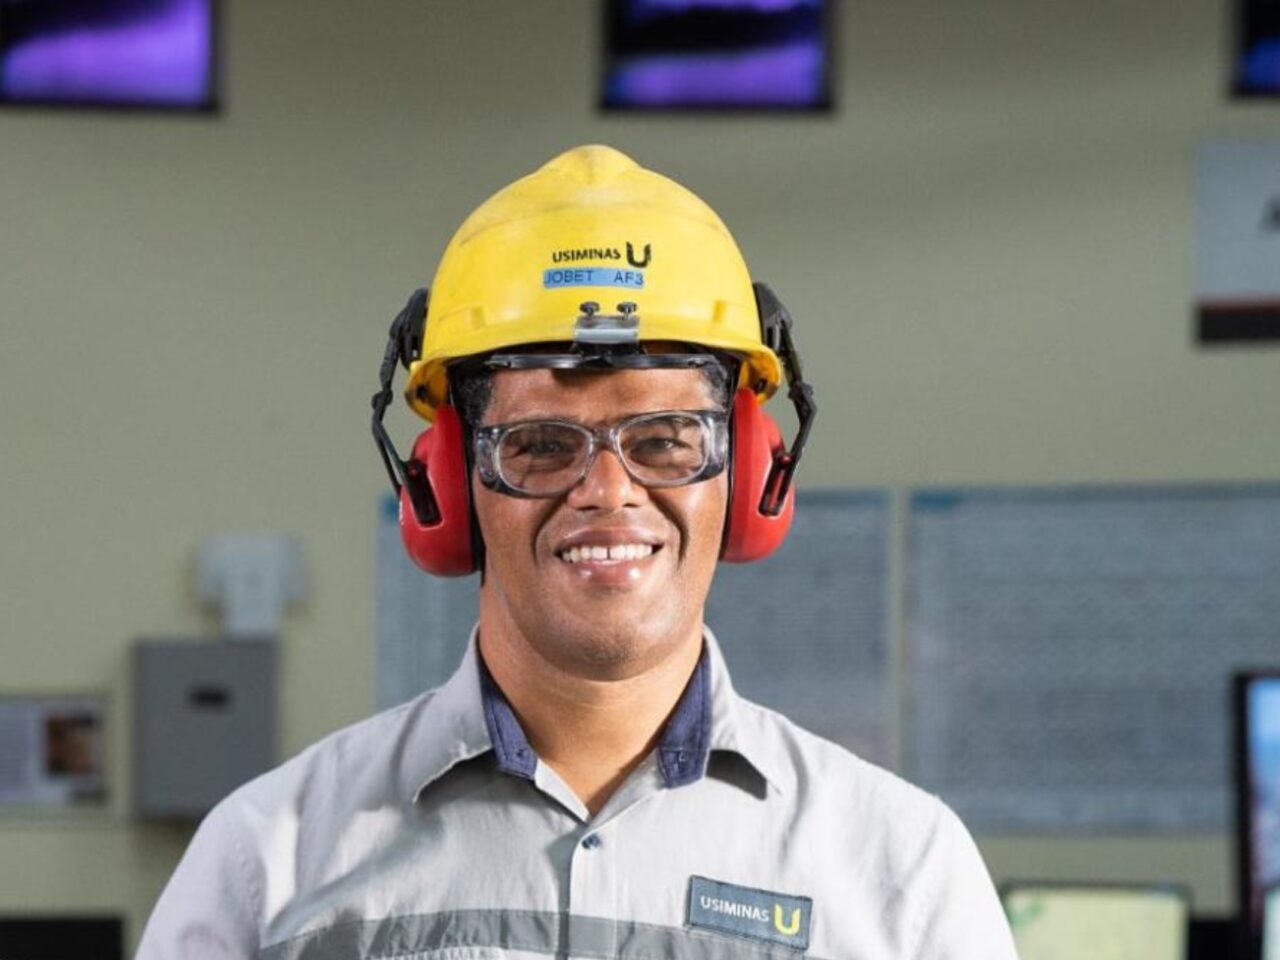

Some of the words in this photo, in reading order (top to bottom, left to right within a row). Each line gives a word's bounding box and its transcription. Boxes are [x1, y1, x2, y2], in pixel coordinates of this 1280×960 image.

[552, 248, 621, 263] USIMINAS
[626, 241, 651, 268] U
[614, 271, 644, 286] AF3
[700, 895, 770, 922] USIMINAS
[774, 903, 801, 935] U
